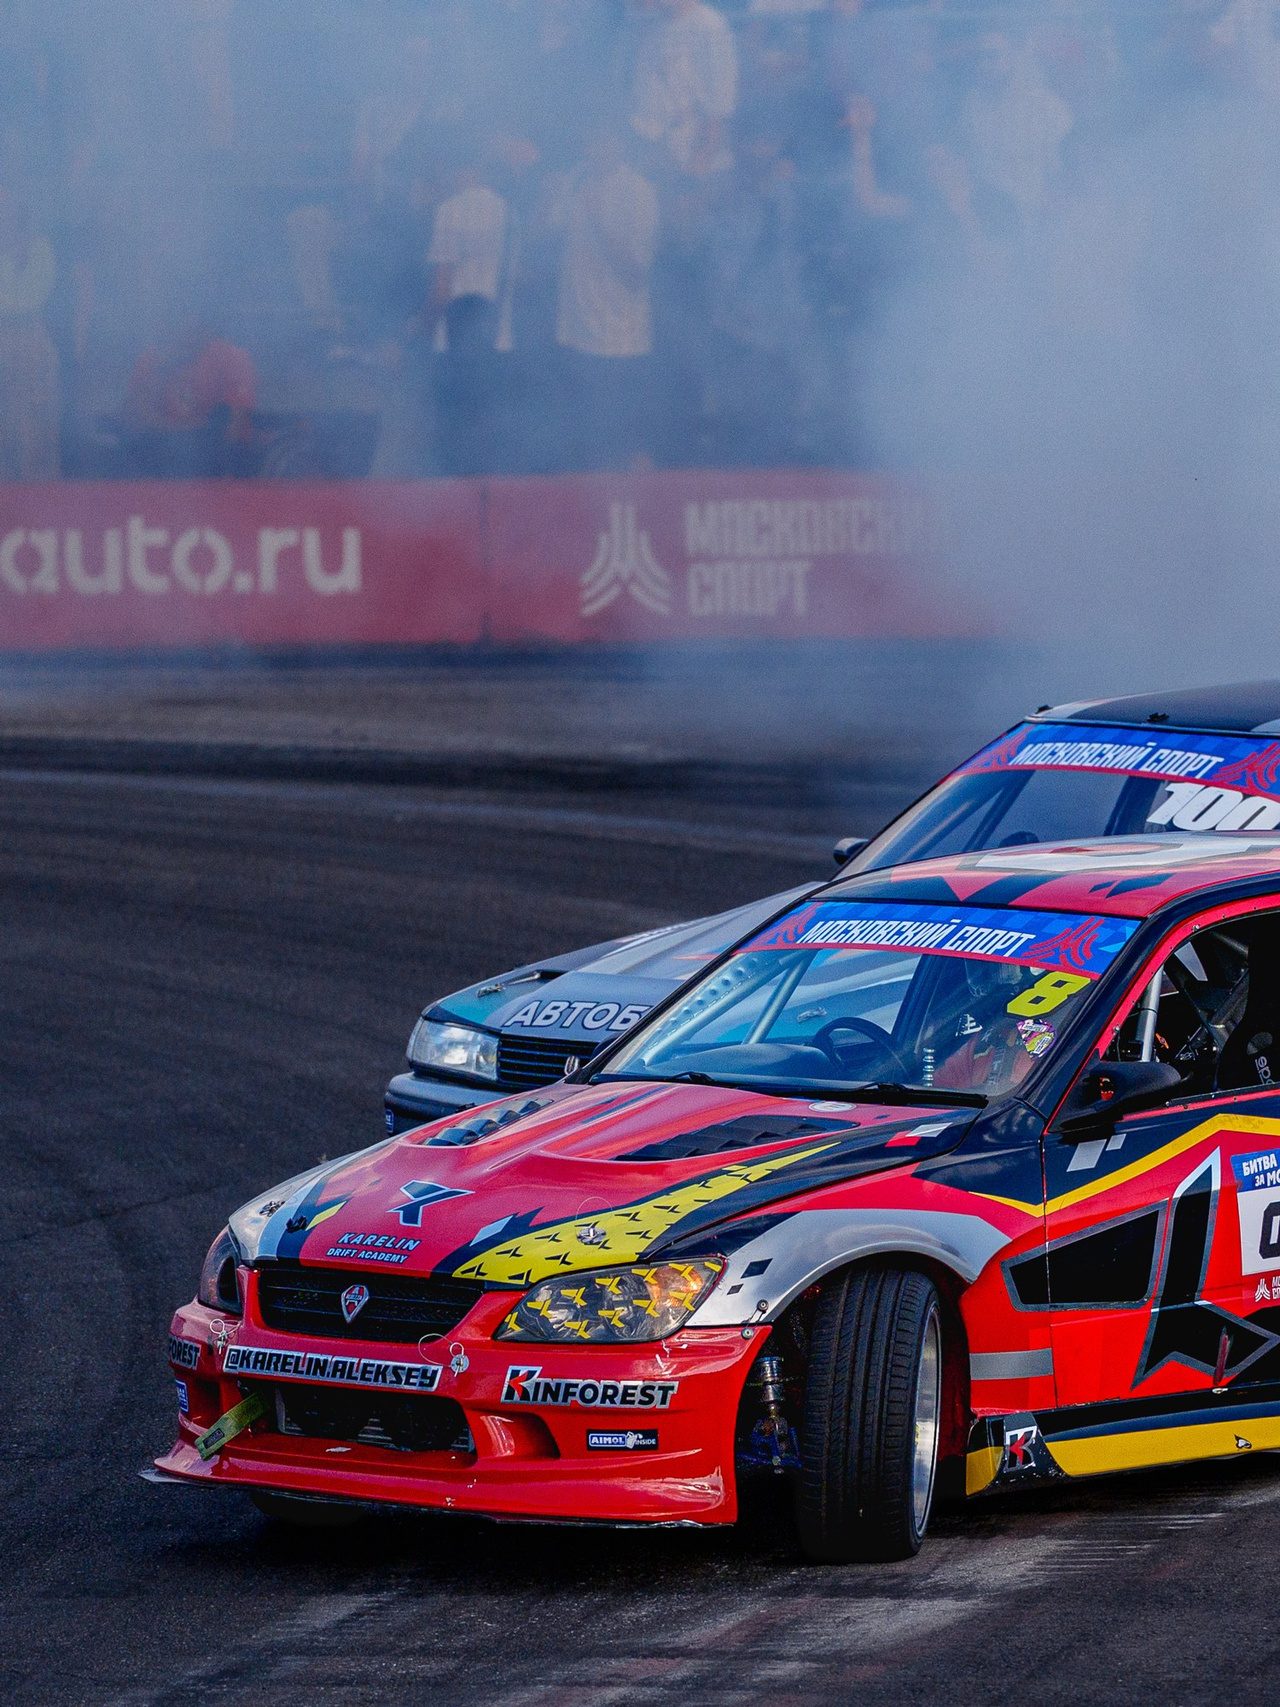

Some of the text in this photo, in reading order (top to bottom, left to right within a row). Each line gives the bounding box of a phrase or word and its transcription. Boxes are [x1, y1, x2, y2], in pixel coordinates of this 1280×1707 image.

[0, 514, 362, 596] auto.ru
[687, 560, 812, 617] СПОРТ
[1008, 741, 1225, 779] МОСКОВСКИЙ СПОРТ
[796, 918, 1036, 957] МОСКОВСКИЙ СПОРТ
[1006, 971, 1091, 1017] 8
[1242, 1153, 1277, 1176] БИТВА
[1254, 1175, 1266, 1187] ЗА
[326, 1247, 410, 1265] DRIFT ACADEMY
[337, 1232, 422, 1252] KARELIN
[224, 1348, 439, 1387] @KARELIN.ALEKSEY
[503, 1366, 679, 1407] KINFOREST
[591, 1436, 625, 1444] AIMOL
